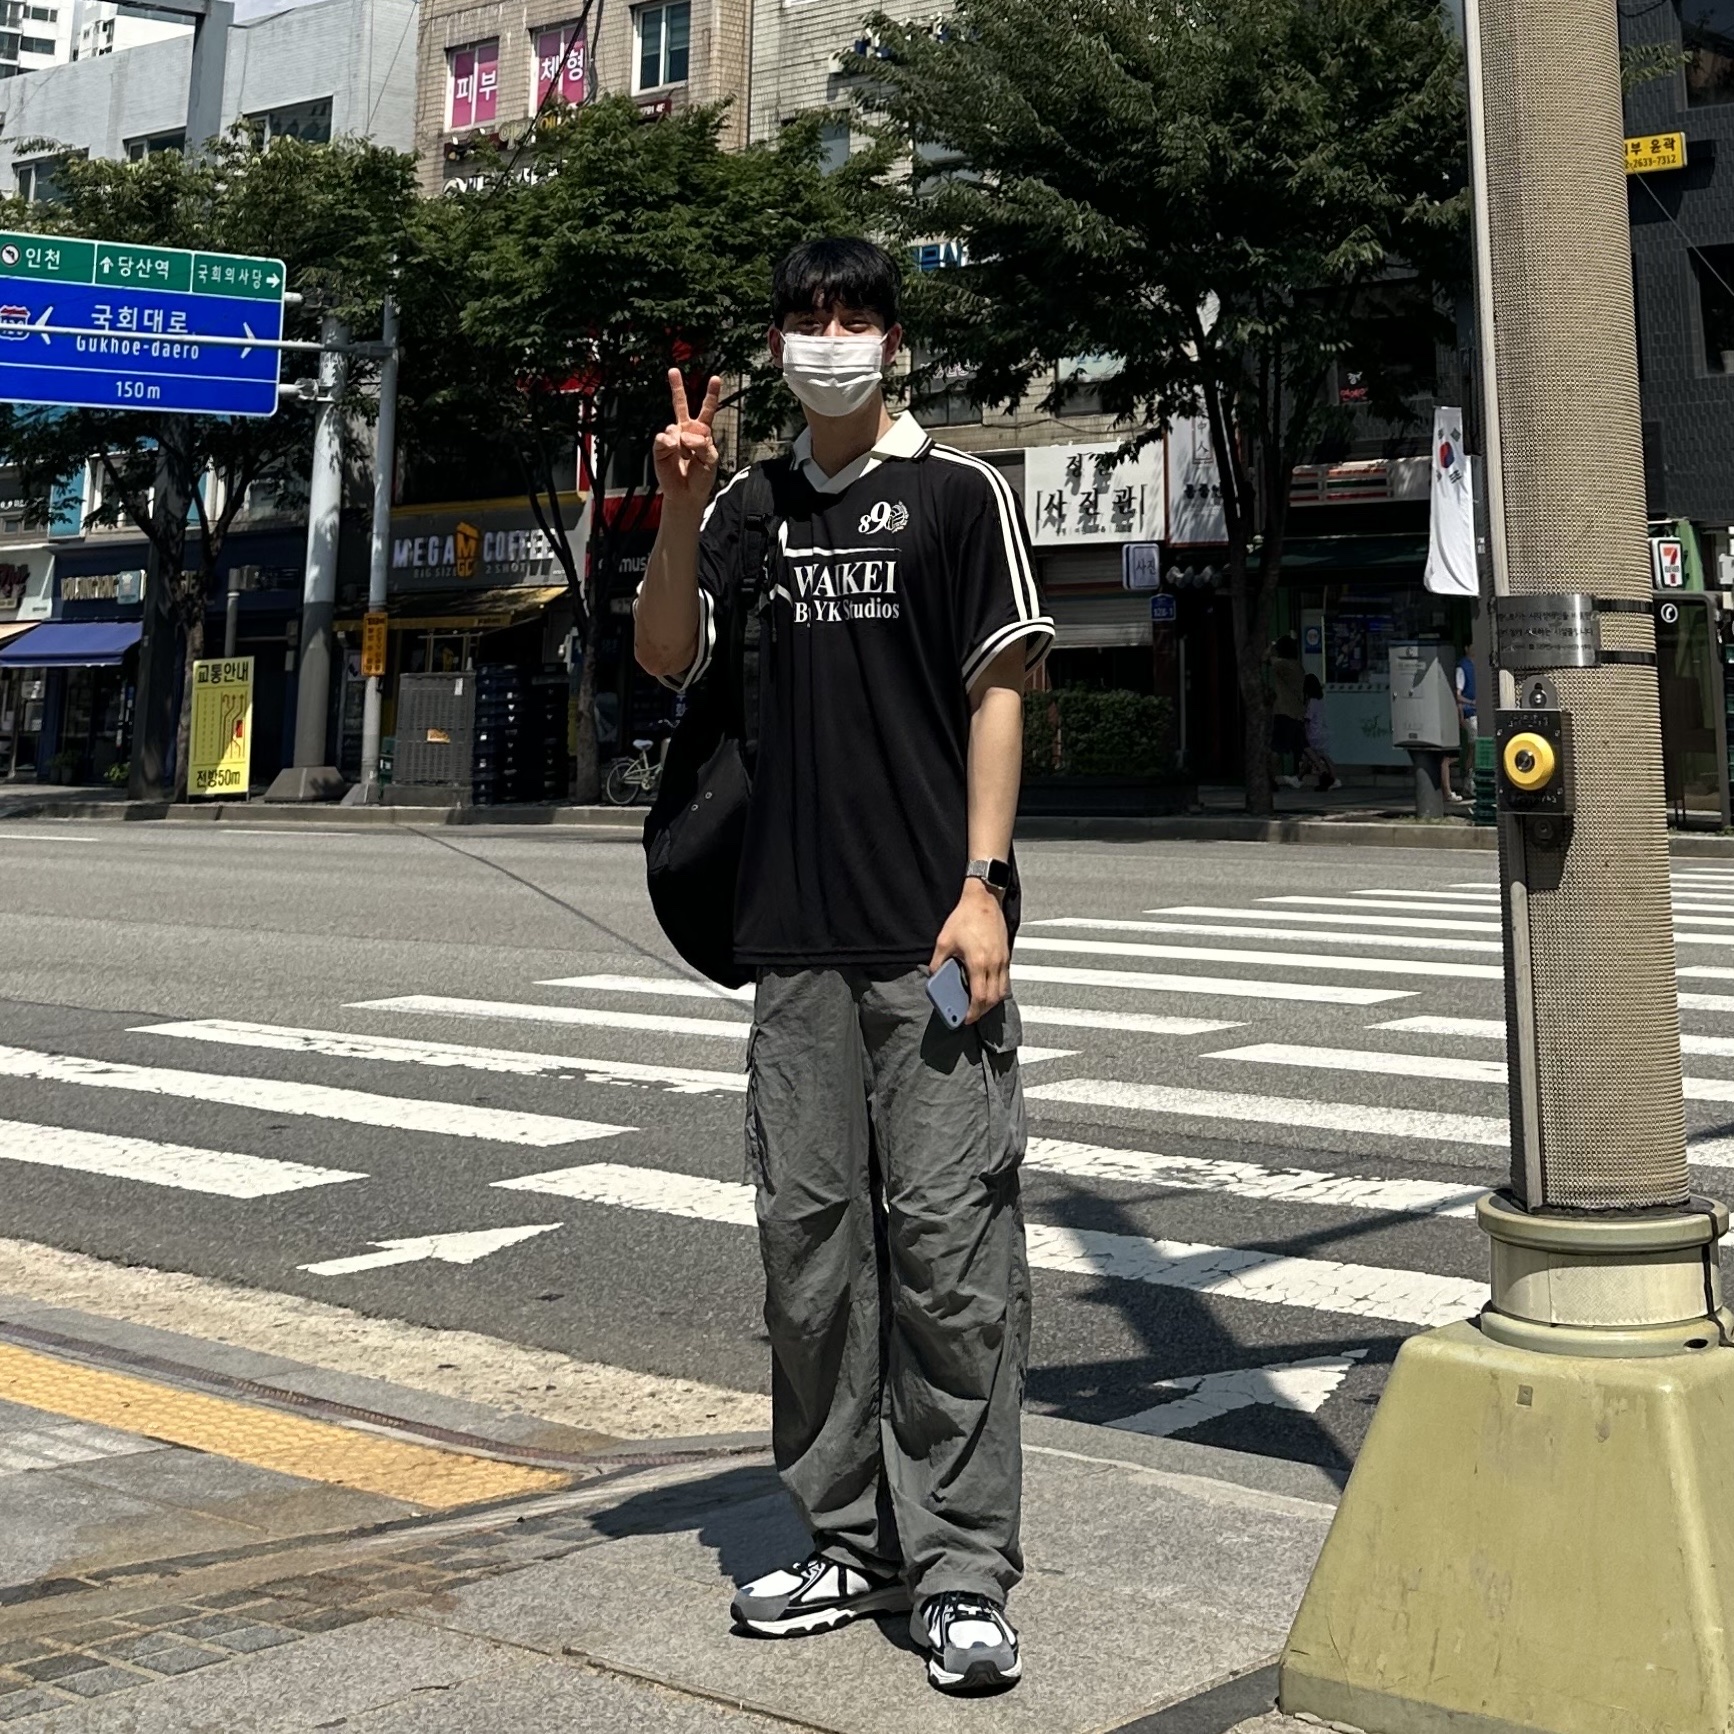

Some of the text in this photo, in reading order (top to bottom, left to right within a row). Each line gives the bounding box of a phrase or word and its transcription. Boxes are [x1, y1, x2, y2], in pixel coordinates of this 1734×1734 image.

[540, 48, 584, 84] 체형
[455, 72, 498, 102] 피부
[25, 246, 61, 270] 인천
[118, 255, 170, 280] 당산역
[198, 263, 262, 290] 국회의사당
[91, 304, 189, 335] 국회대로
[76, 335, 200, 361] Gukhoe-daero
[1044, 484, 1138, 520] 사진관
[858, 501, 892, 535] 89
[392, 535, 455, 568] MEGA
[618, 555, 650, 573] mus
[1136, 556, 1157, 576] 사진
[813, 599, 843, 622] YK
[842, 597, 900, 621] Studios
[197, 661, 249, 684] 교통안내
